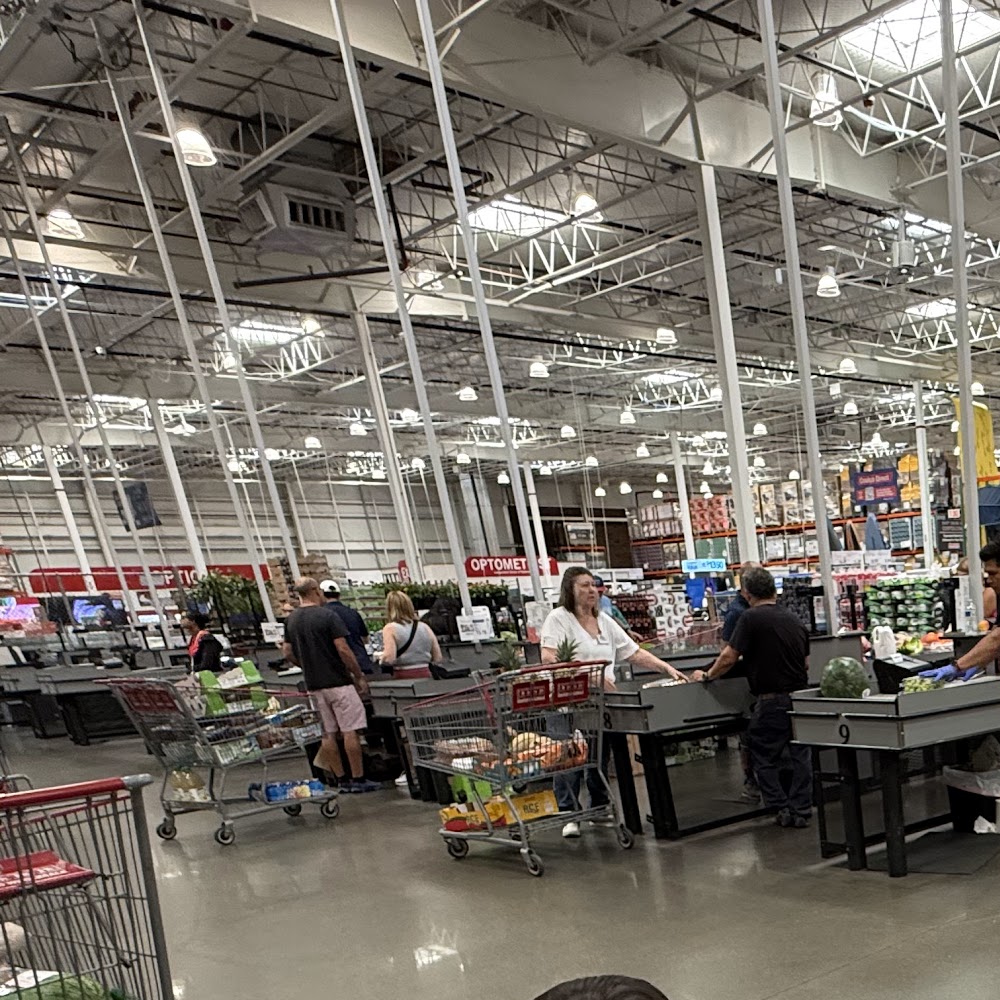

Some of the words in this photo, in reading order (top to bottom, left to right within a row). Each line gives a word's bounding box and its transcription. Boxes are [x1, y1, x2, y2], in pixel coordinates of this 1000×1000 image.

[470, 557, 551, 571] OPTOMETST
[603, 712, 612, 729] 8
[839, 724, 850, 744] 9
